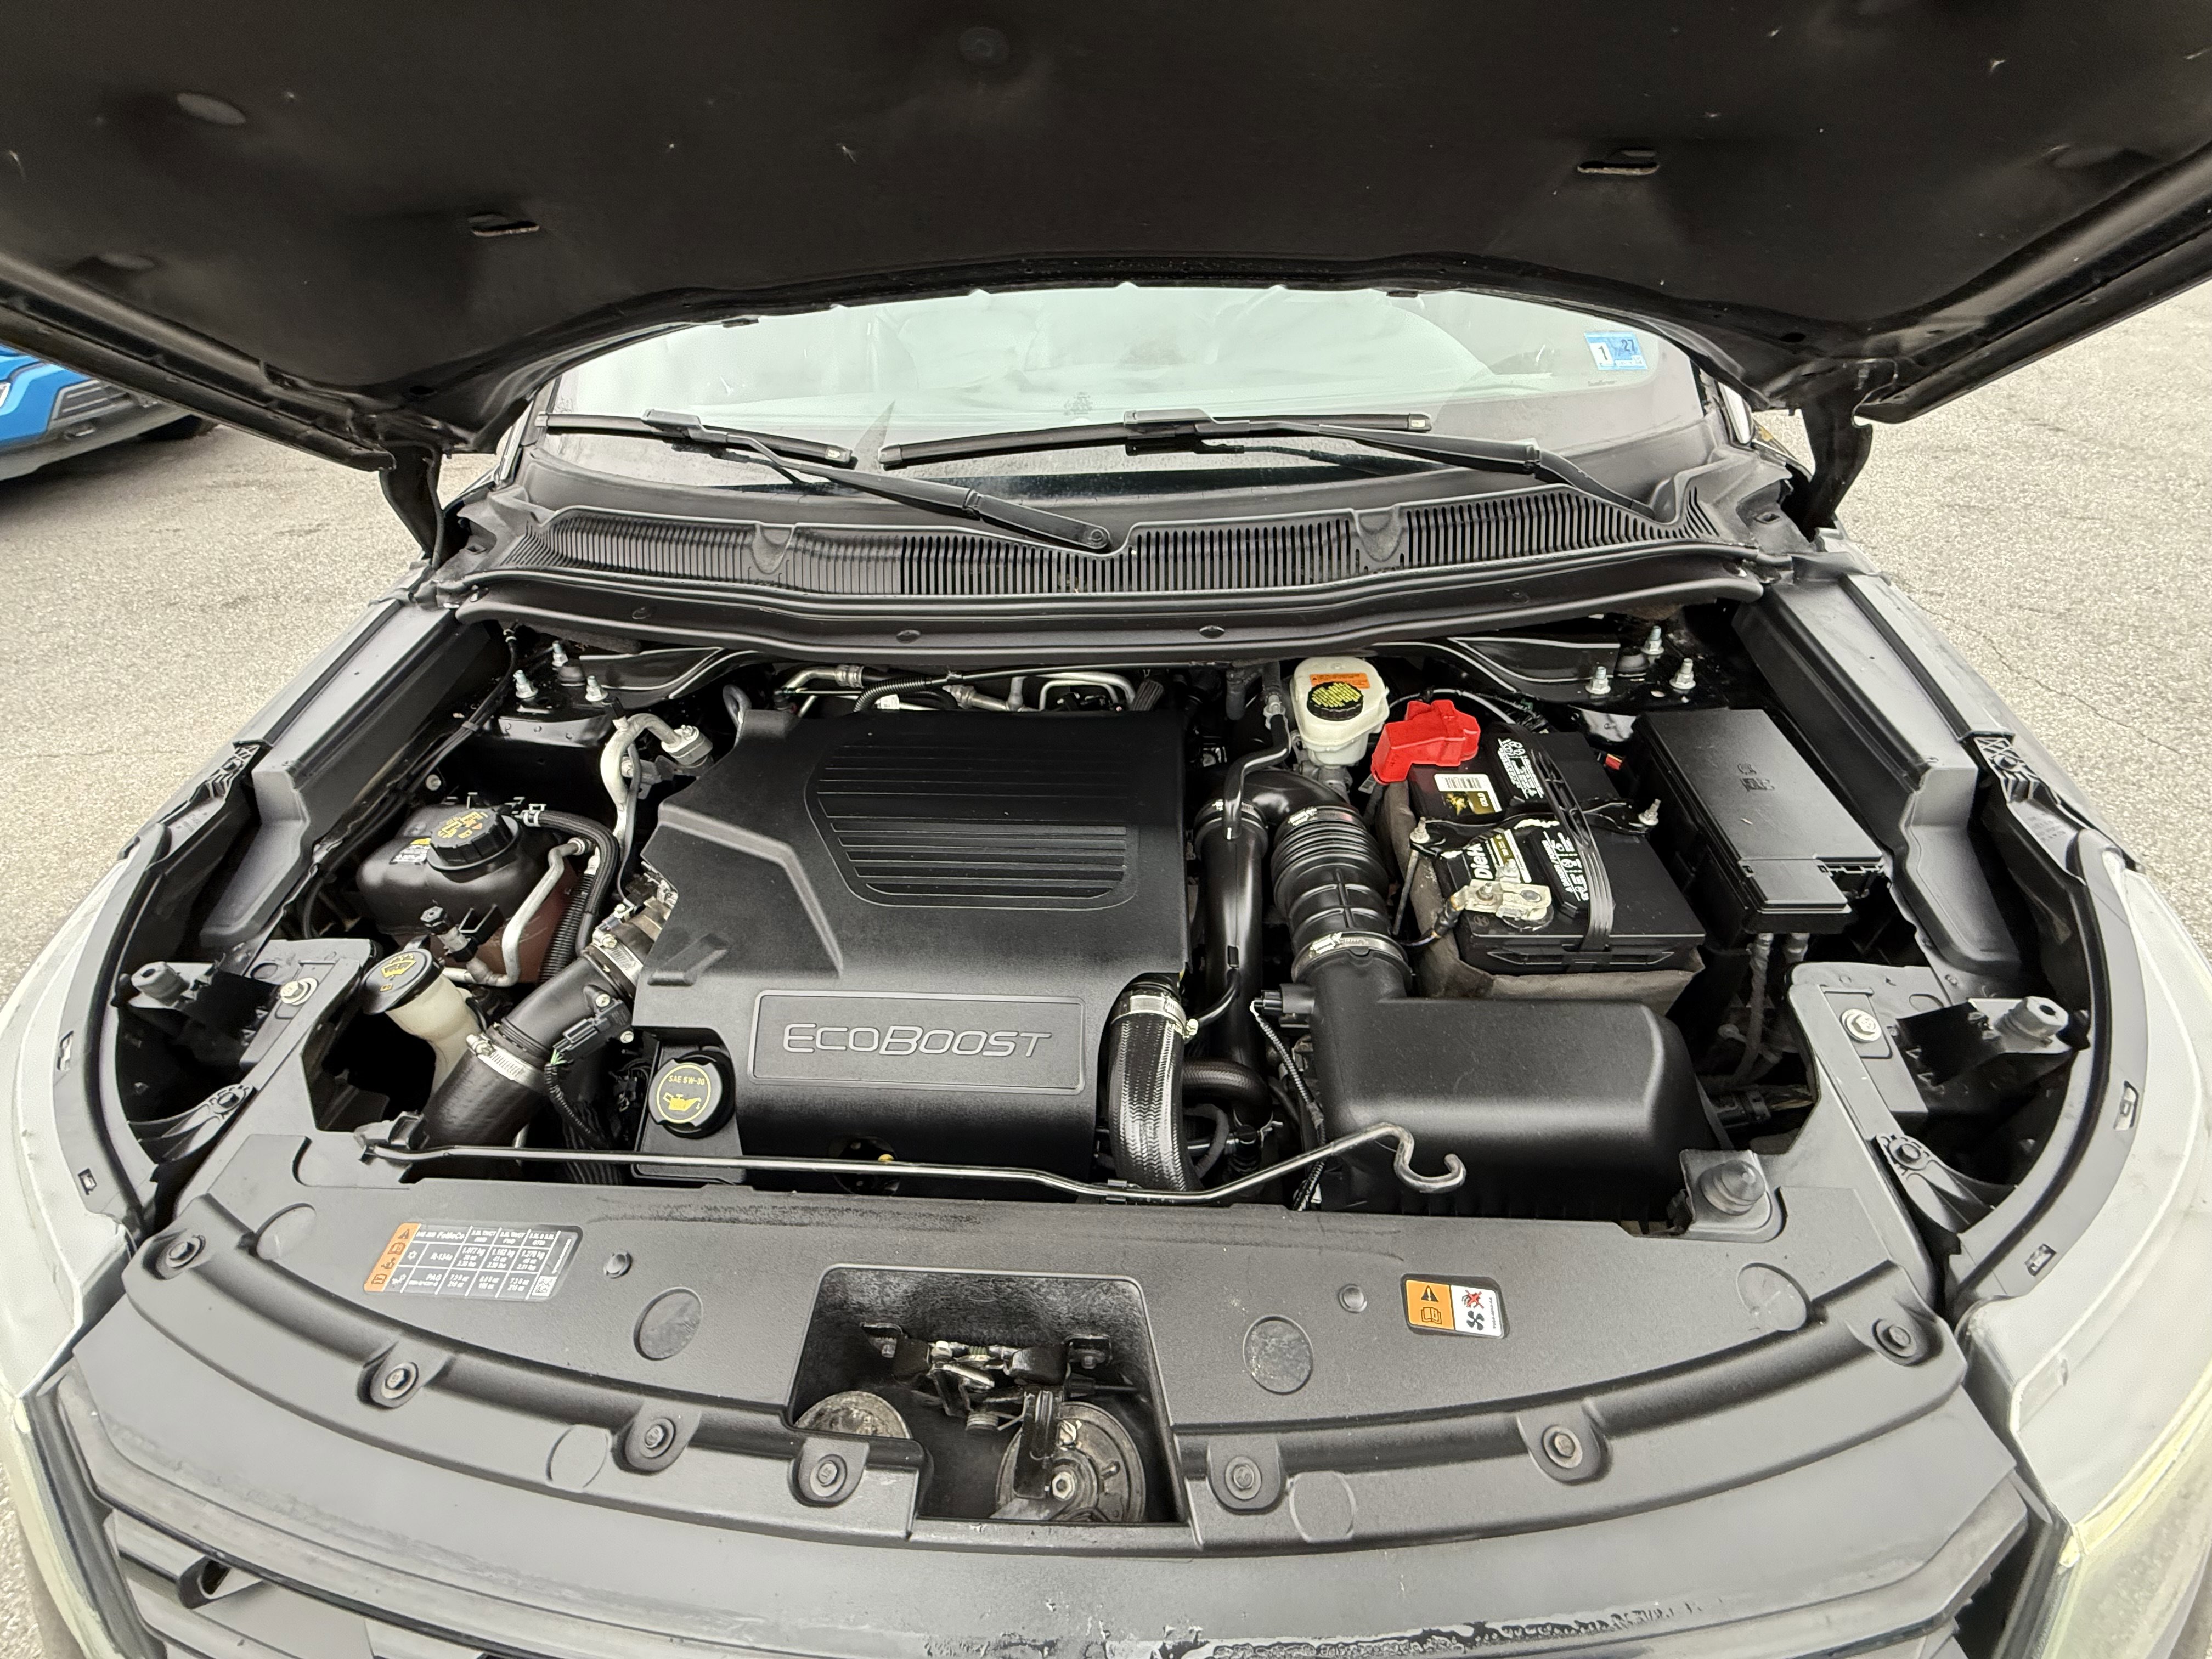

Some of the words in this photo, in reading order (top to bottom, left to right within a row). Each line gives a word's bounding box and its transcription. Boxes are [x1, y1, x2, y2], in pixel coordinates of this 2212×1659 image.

[1621, 339, 1635, 352] 27
[1598, 346, 1608, 360] 1
[1466, 843, 1493, 879] DieH
[668, 1075, 683, 1084] SAE
[683, 1076, 705, 1085] 5W-30
